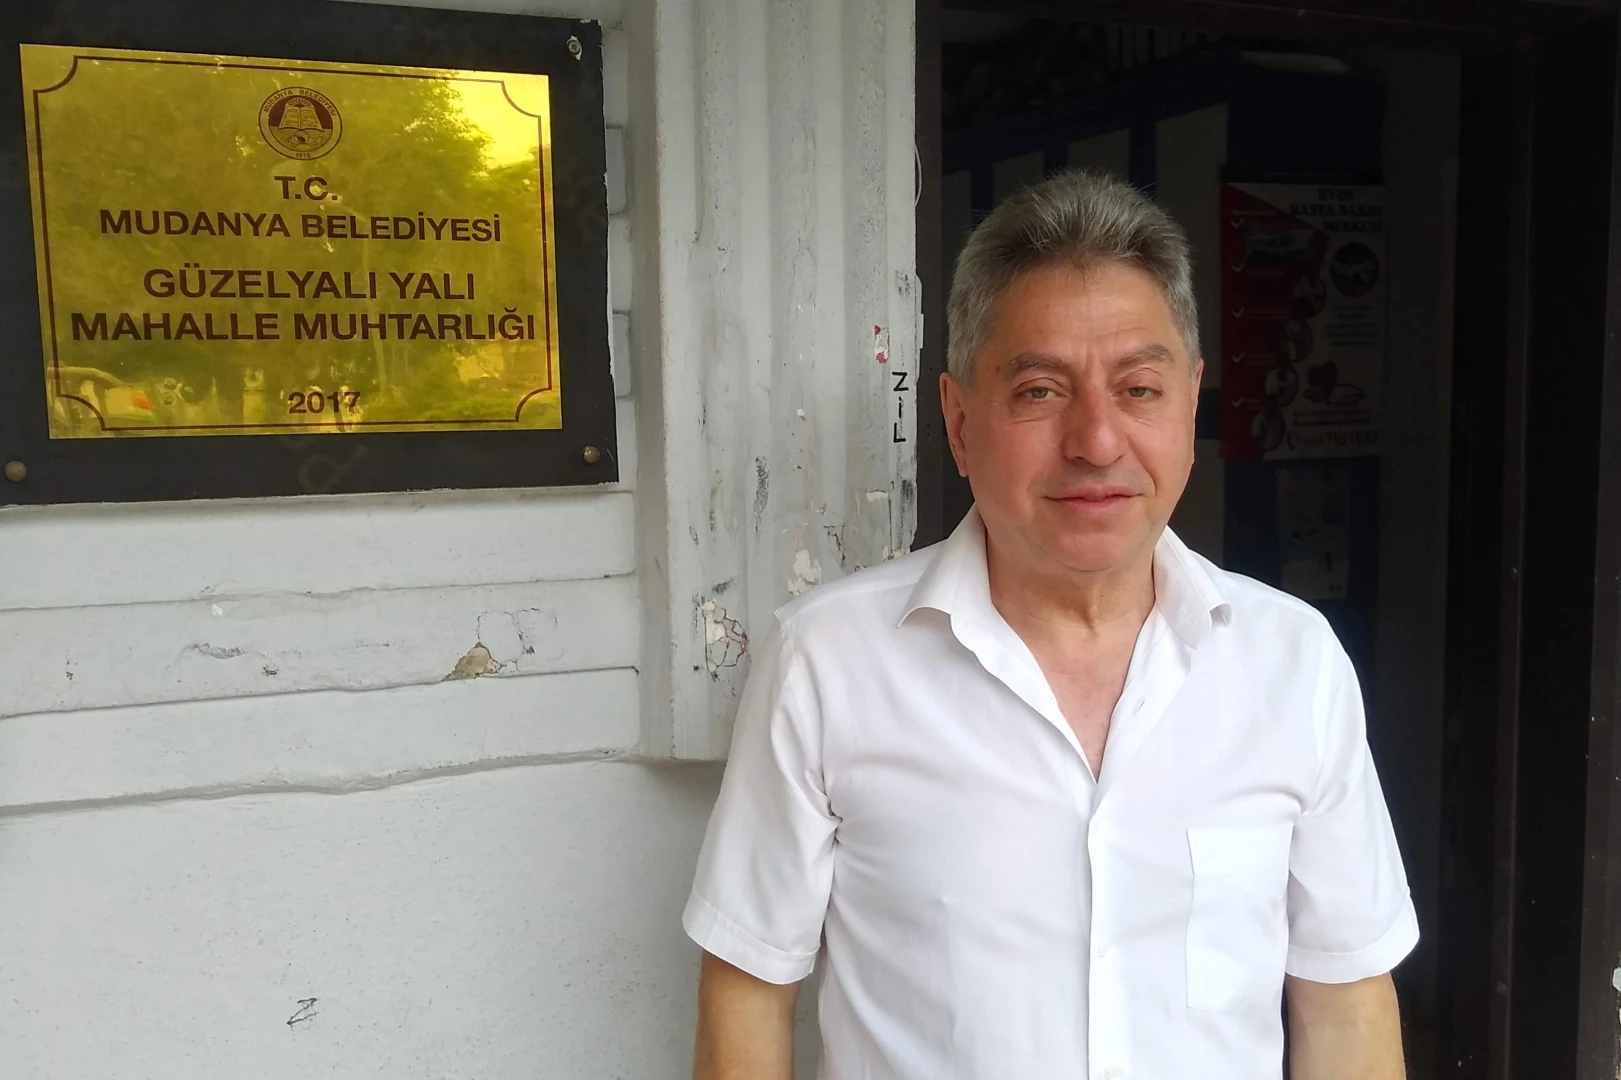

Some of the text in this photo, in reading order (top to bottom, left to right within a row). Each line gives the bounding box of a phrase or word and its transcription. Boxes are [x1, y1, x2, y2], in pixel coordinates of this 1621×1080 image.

[263, 90, 293, 112] MUDANYA
[274, 176, 339, 201] T.C.
[1290, 203, 1335, 215] HASTA
[100, 209, 501, 242] MUDANYA BELEDİYESİ
[143, 263, 475, 300] GÜZELYALI YALI
[72, 307, 535, 341] MAHALLE MUHTARLIĞI
[289, 391, 360, 414] 2017
